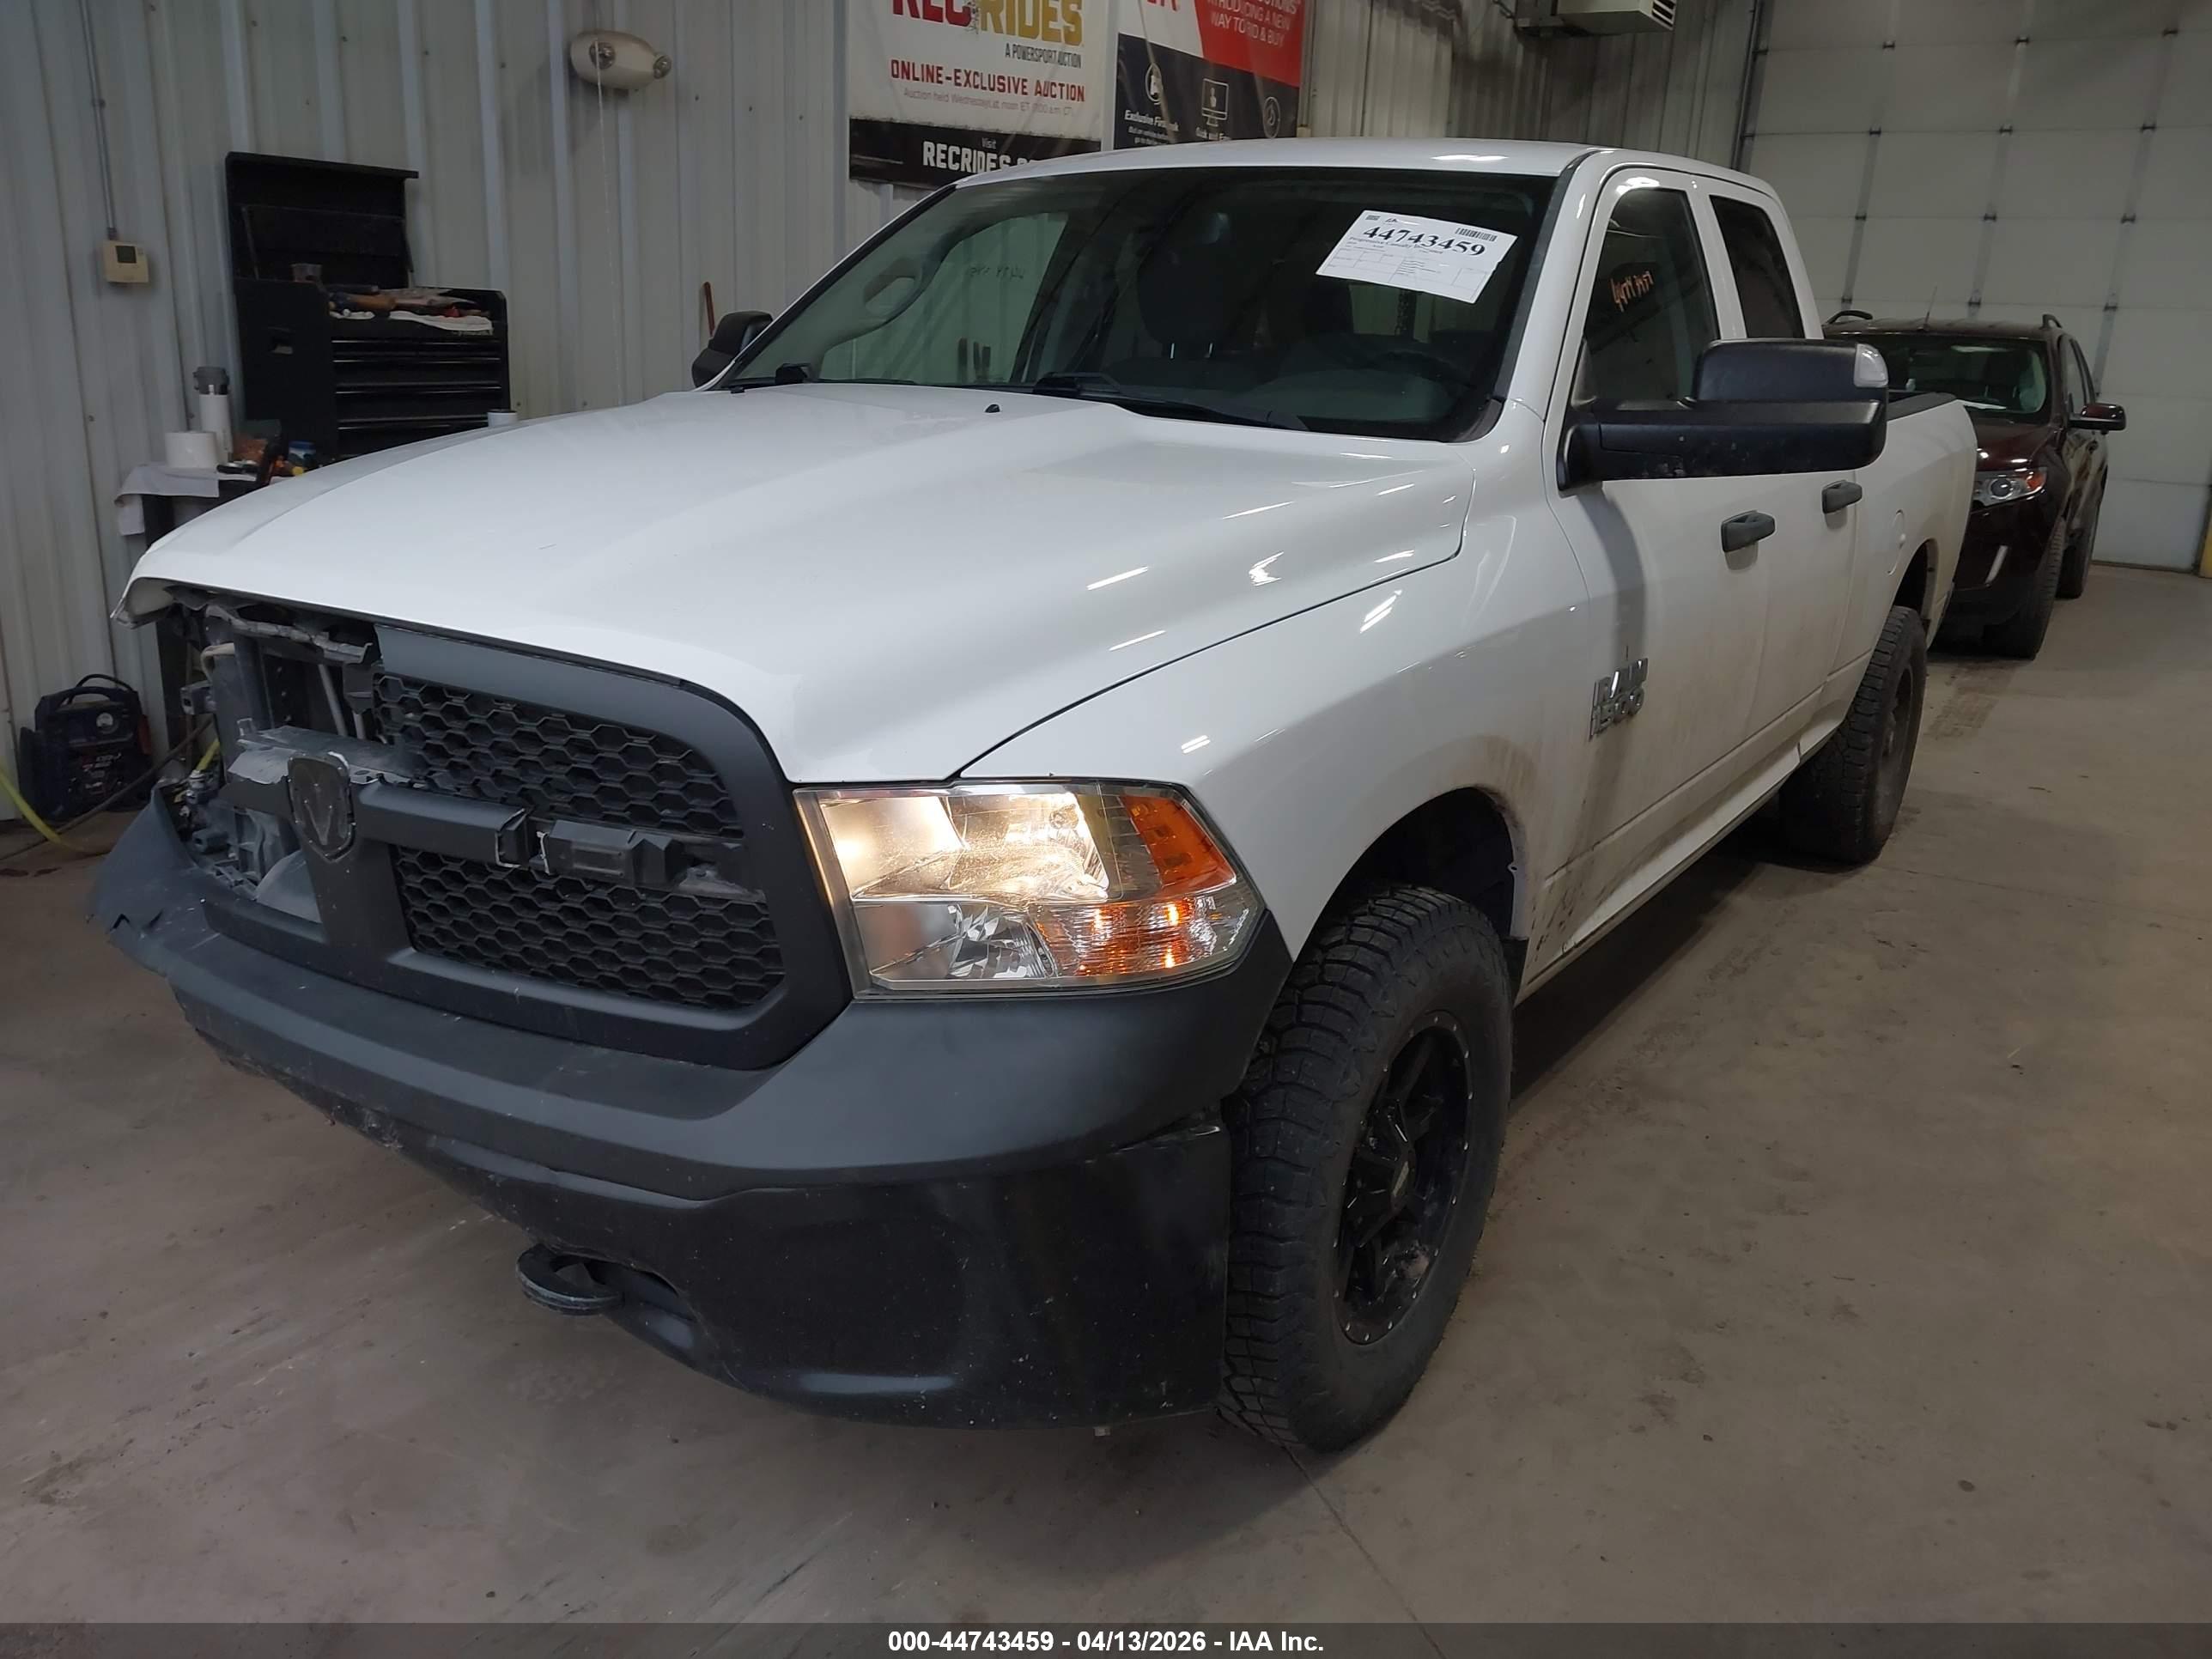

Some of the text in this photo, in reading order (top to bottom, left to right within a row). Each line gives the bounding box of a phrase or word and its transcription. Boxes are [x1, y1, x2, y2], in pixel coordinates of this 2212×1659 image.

[1211, 10, 1232, 29] WAY
[1005, 43, 1011, 58] A
[890, 59, 1085, 102] ONLINE-EXCLUSIVE AUCTION
[1363, 226, 1486, 257] 44743459
